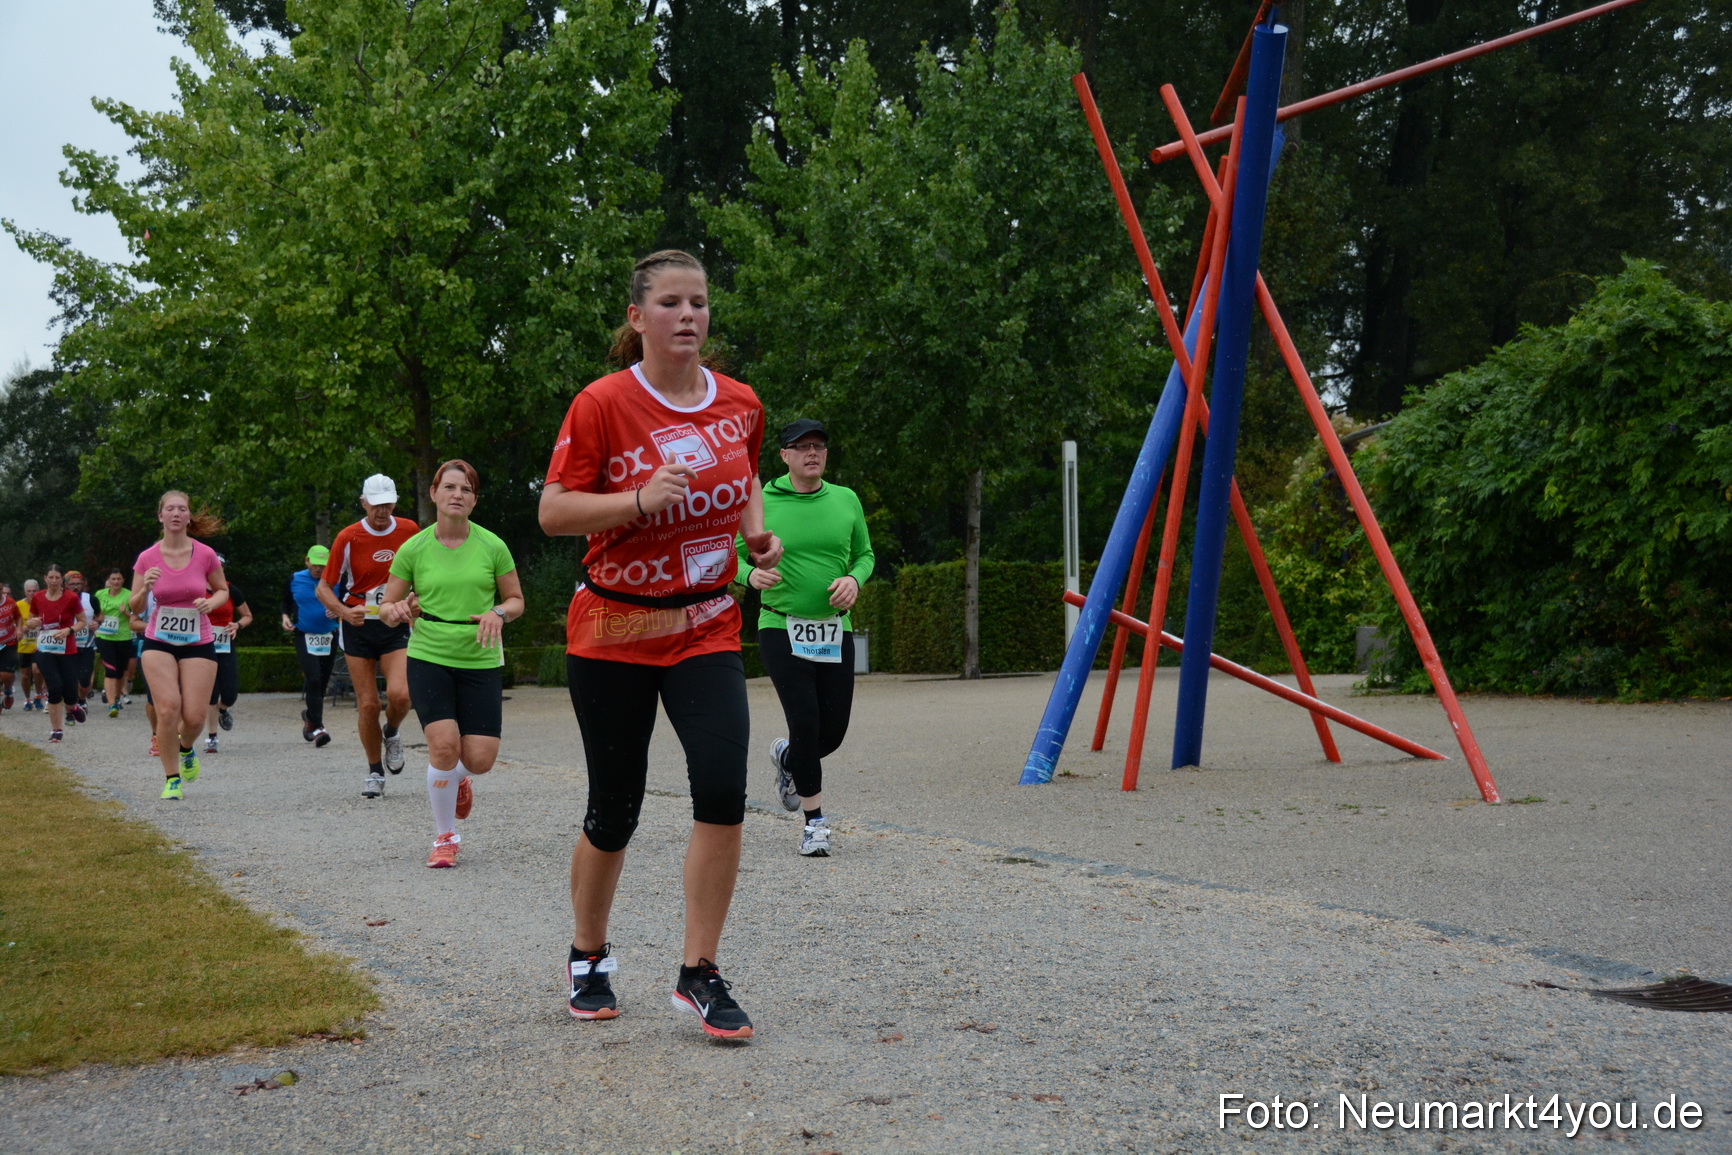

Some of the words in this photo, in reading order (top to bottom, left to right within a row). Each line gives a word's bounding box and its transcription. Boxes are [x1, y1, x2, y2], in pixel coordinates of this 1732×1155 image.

[655, 427, 695, 444] raumbox
[604, 446, 653, 483] ox
[685, 539, 729, 555] raumbox
[602, 552, 672, 586] box
[160, 616, 196, 632] 2201
[588, 606, 686, 639] Team
[793, 623, 838, 643] 2617
